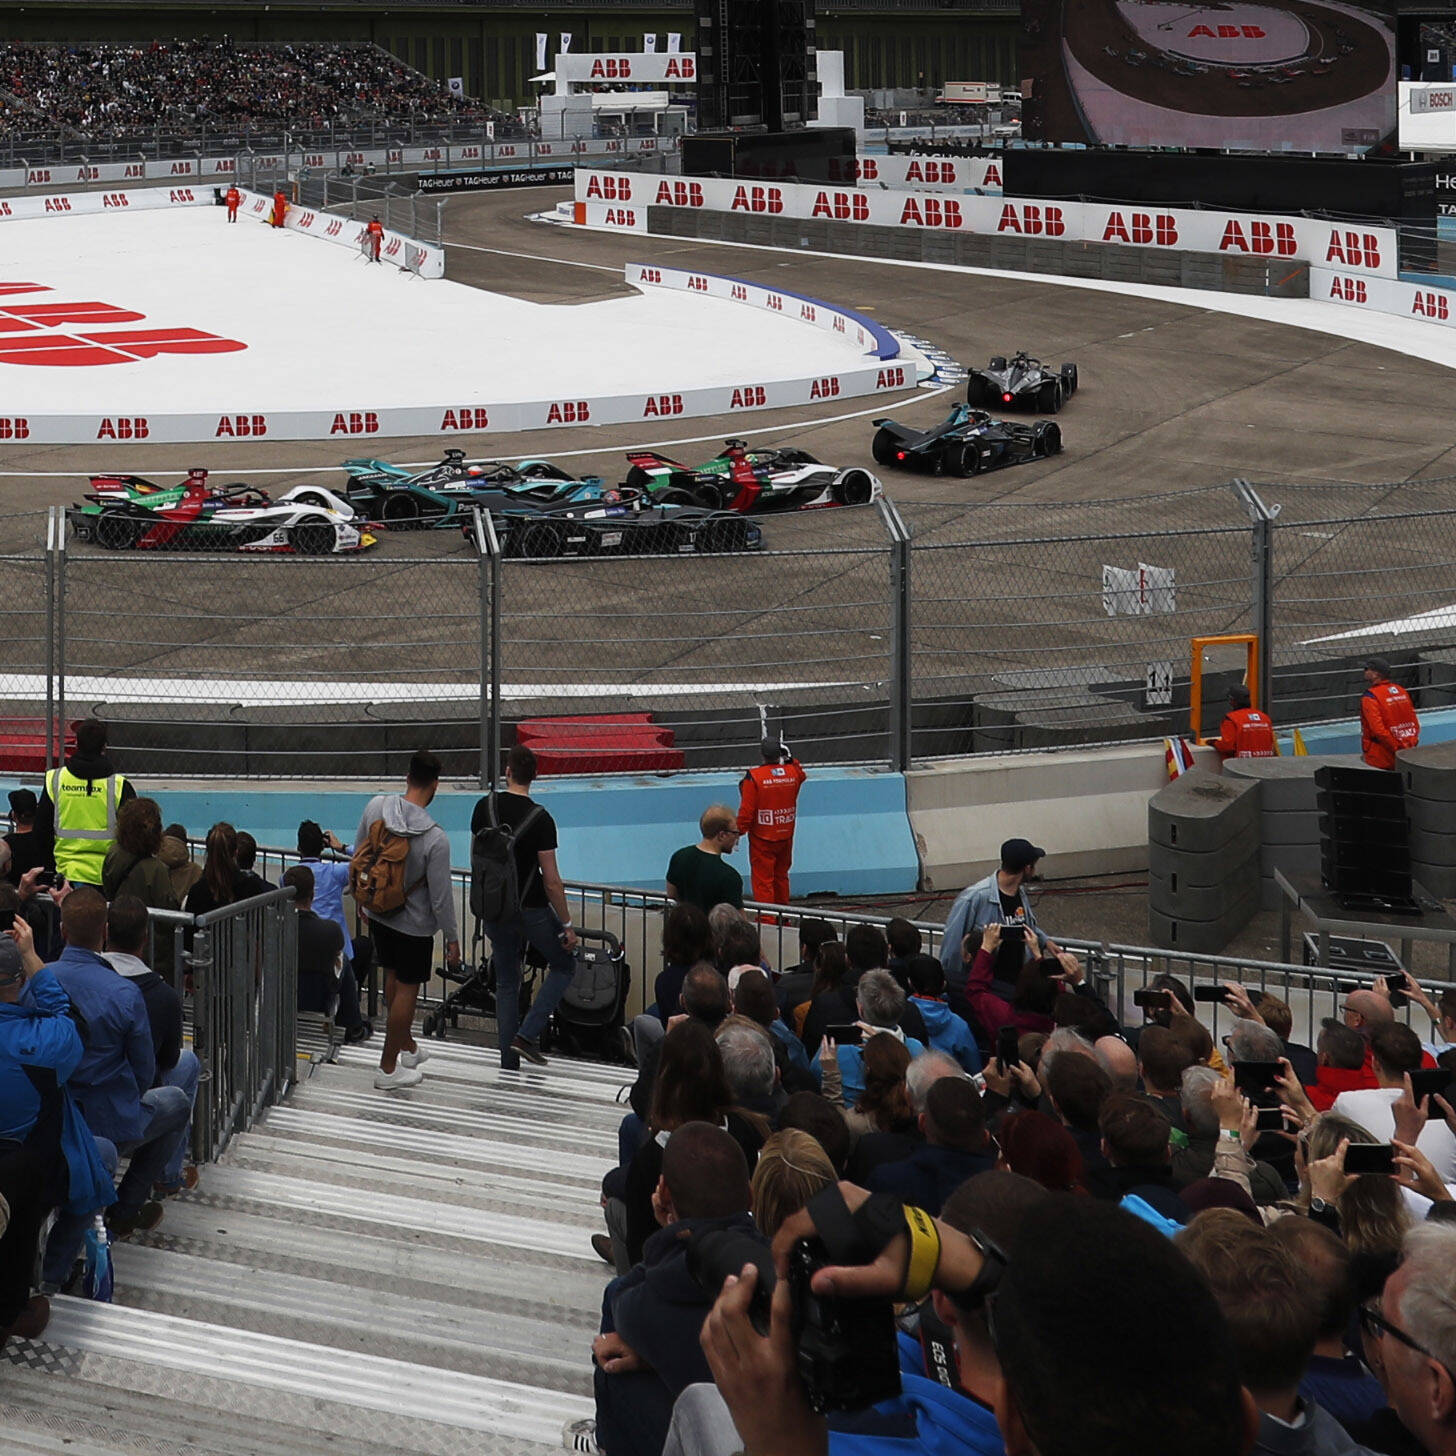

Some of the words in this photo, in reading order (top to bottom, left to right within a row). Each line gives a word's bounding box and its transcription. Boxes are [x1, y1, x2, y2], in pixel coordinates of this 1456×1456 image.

[1187, 24, 1266, 39] ABB
[591, 59, 631, 78] ABB
[664, 59, 694, 78] AB
[1430, 93, 1453, 107] BOSCH
[28, 170, 51, 184] ABB
[171, 162, 191, 175] ABB
[905, 161, 956, 183] ABB
[45, 197, 71, 212] ABB
[103, 193, 128, 207] ABB
[169, 189, 194, 203] ABB
[586, 175, 632, 201] ABB
[655, 181, 704, 207] ABB
[731, 186, 783, 214] ABB
[812, 192, 870, 221] ABB
[900, 198, 963, 228] ABB
[997, 204, 1065, 236] ABB
[1102, 212, 1179, 245] ABB
[1220, 220, 1297, 255] ABB
[1326, 230, 1381, 268] ABB
[605, 208, 635, 226] ABB
[640, 269, 661, 283] ABB
[687, 276, 707, 291] ABB
[1330, 276, 1367, 303] ABB
[1412, 291, 1449, 319] ABB
[97, 418, 149, 439] ABB
[215, 415, 267, 437] ABB
[330, 412, 379, 434] ABB
[441, 408, 489, 430] ABB
[547, 401, 590, 424] ABB
[644, 394, 683, 417] ABB
[731, 386, 766, 409] ABB
[810, 377, 840, 400] ABB
[877, 368, 904, 389] ABB
